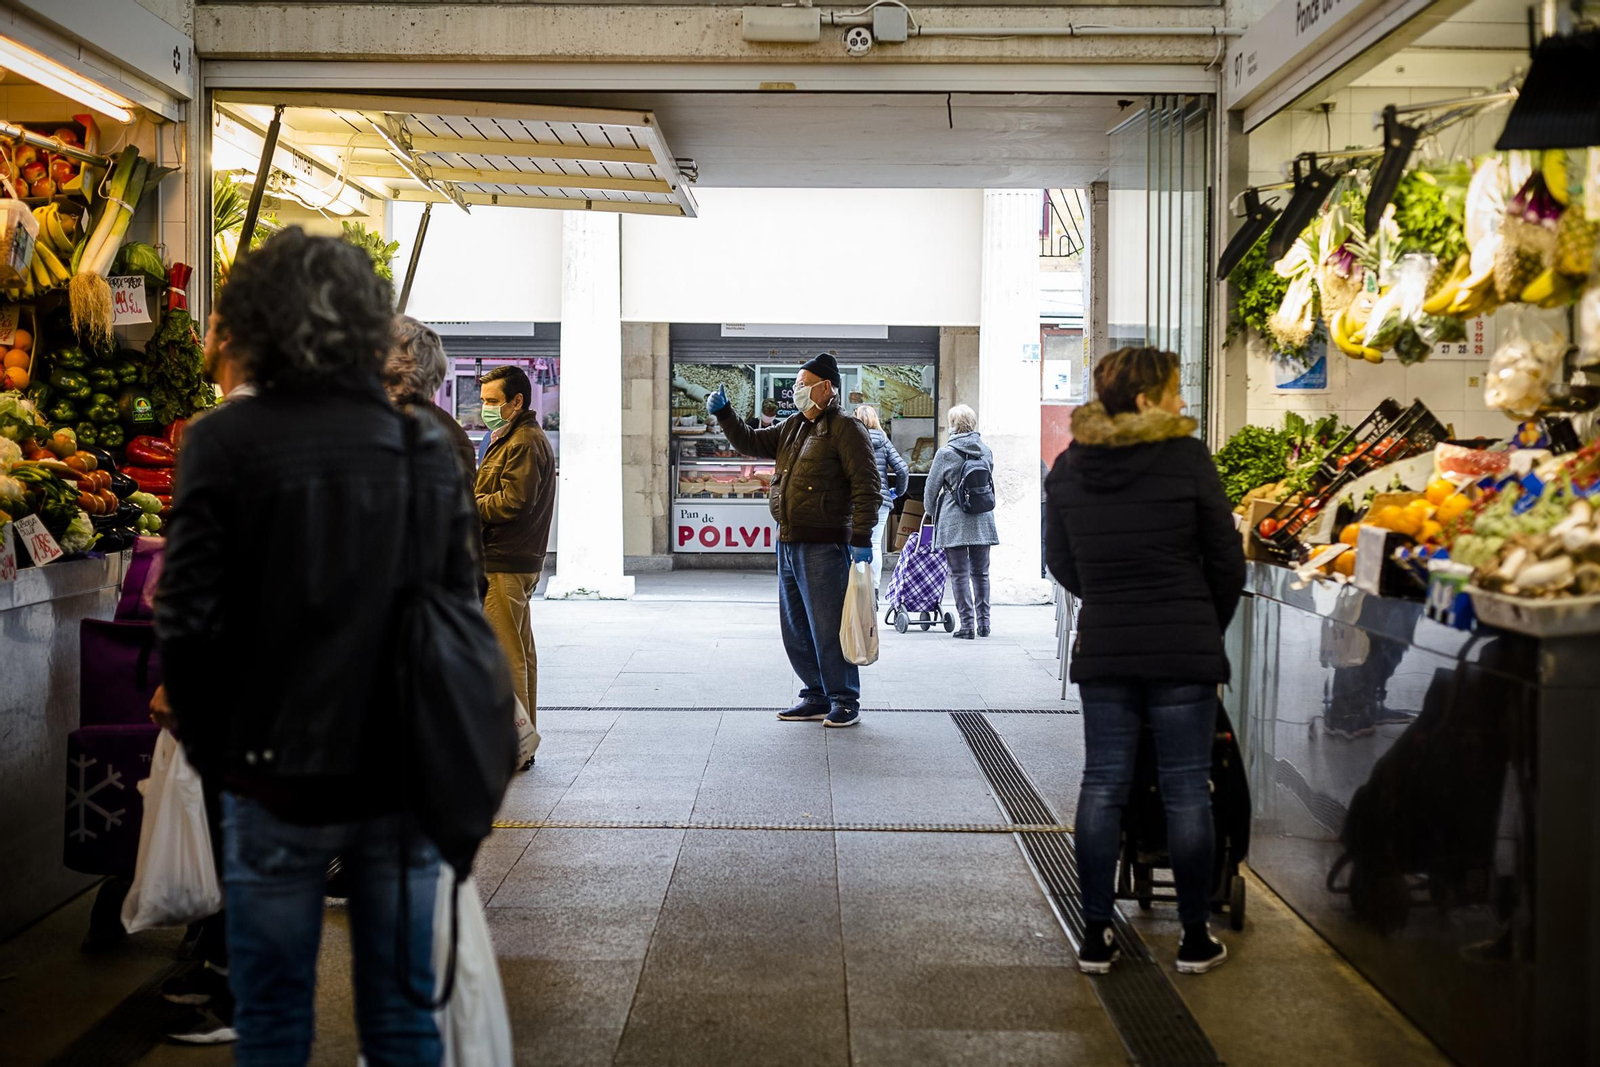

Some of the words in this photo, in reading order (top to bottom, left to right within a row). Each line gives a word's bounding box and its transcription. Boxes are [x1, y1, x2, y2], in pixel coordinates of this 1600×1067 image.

[1234, 52, 1243, 89] 97
[1474, 333, 1483, 342] 22
[1442, 344, 1450, 354] 27
[1458, 344, 1467, 354] 28
[680, 509, 699, 519] Pan
[702, 513, 714, 523] de
[678, 525, 771, 548] POLVI
